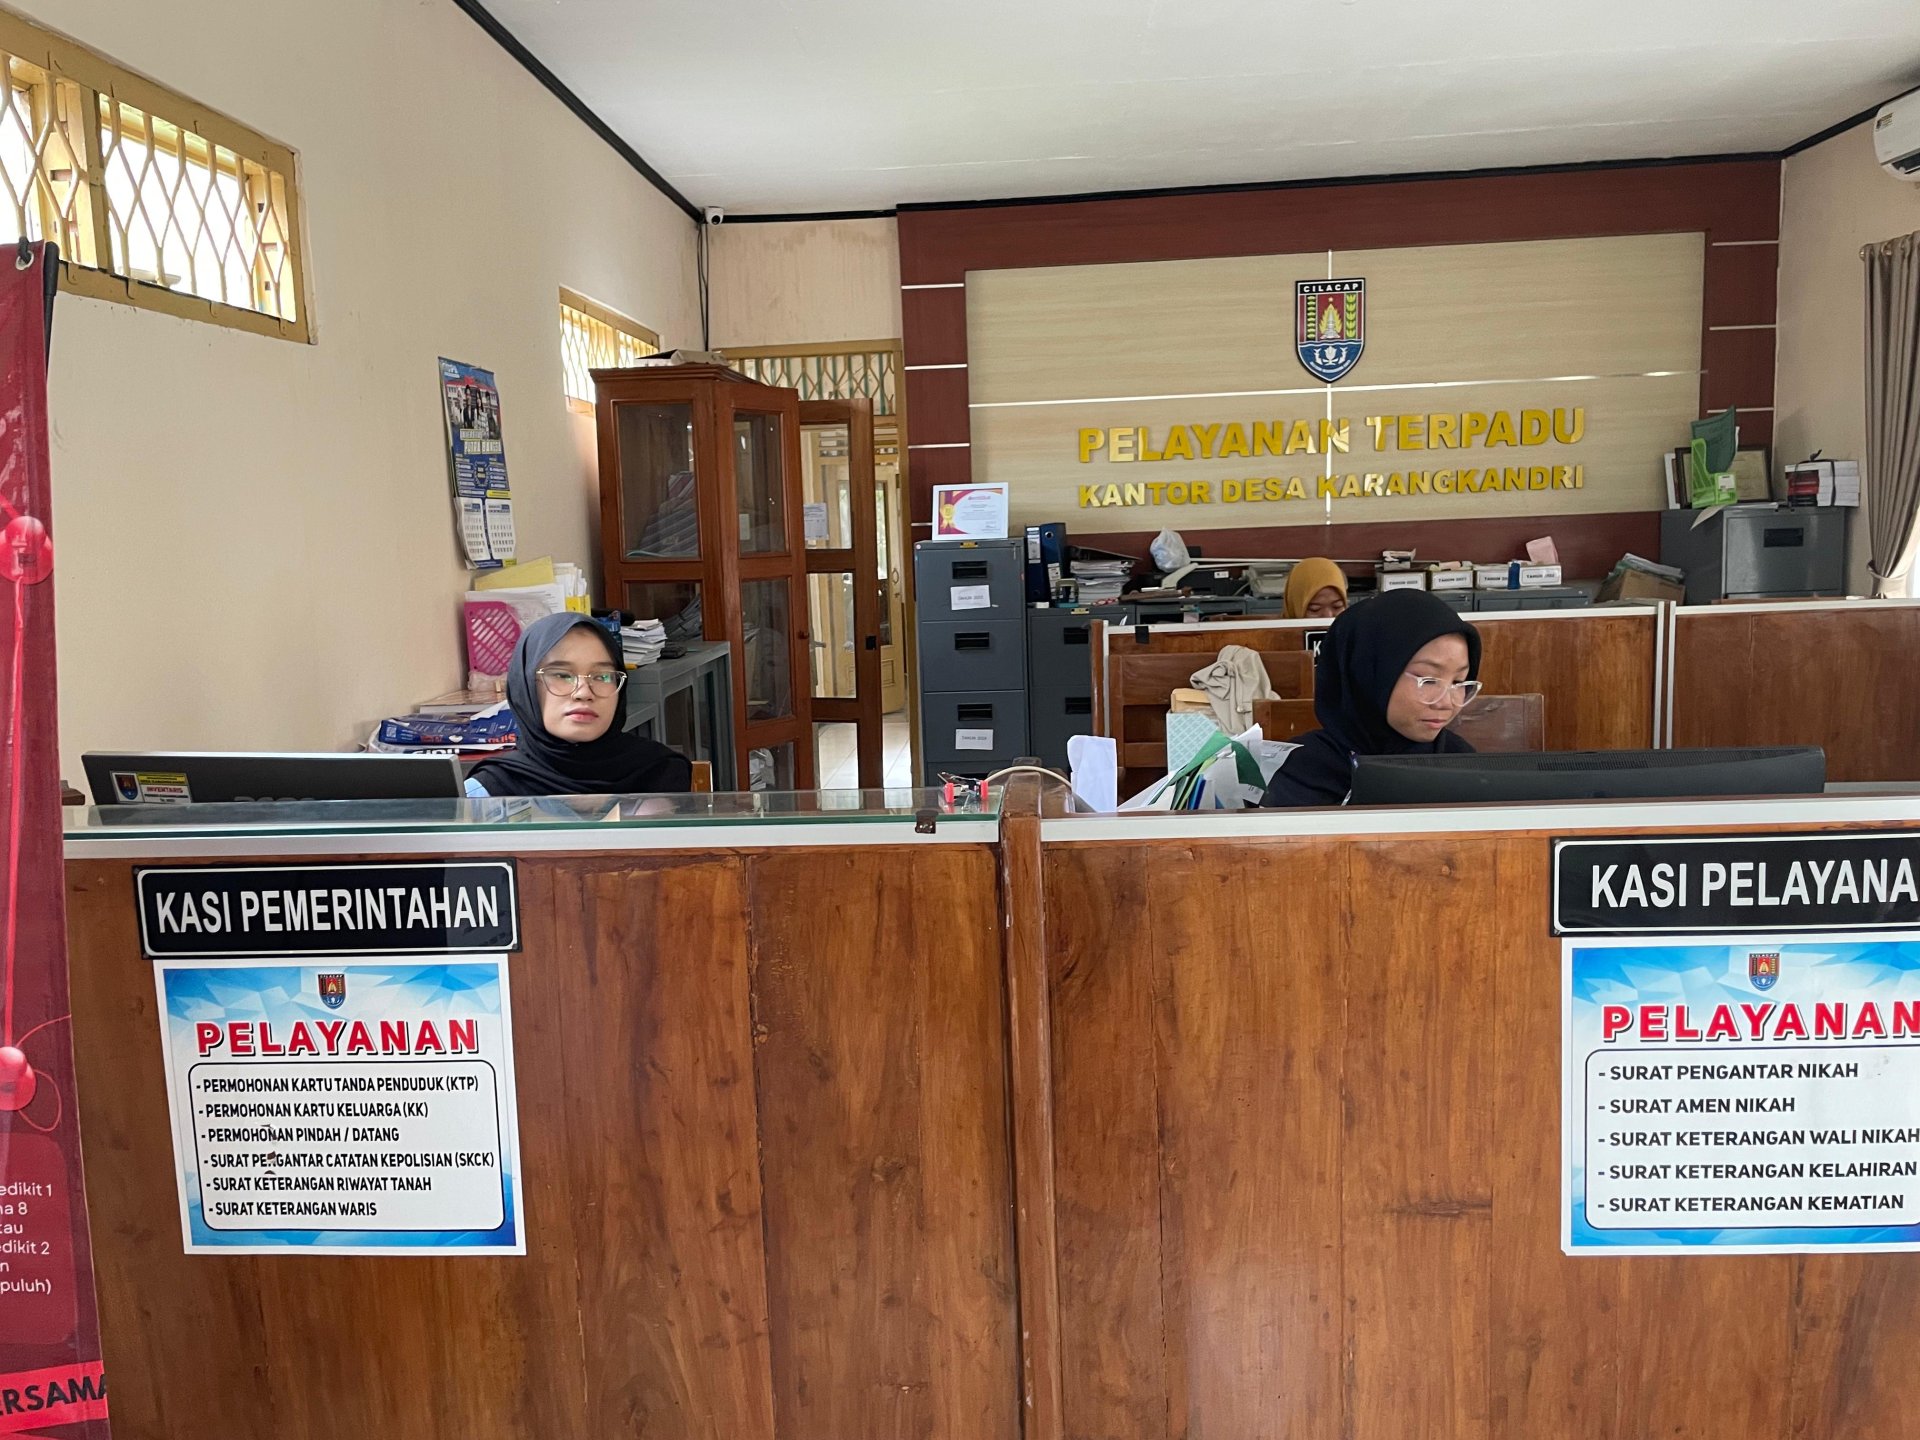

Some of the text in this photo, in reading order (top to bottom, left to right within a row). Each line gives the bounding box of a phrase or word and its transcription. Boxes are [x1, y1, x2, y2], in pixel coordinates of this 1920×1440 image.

[1303, 283, 1359, 293] CILACAP
[1078, 407, 1585, 462] PELAYANAN TERPADU
[1079, 464, 1585, 507] KANTOR DESA KARANGKANDRI
[1591, 858, 1919, 908] KASI PELAYANA
[156, 885, 499, 933] KASI PEMERINTAHAN
[1603, 1000, 1920, 1043] PELAYANAN
[196, 1019, 480, 1058] PELAYANAN
[1610, 1065, 1673, 1081] SURAT
[1677, 1064, 1793, 1080] PENGANTAR
[1798, 1062, 1858, 1078] NIKAH
[203, 1077, 289, 1093] PERMOHONAN
[291, 1077, 333, 1092] KARTU
[333, 1077, 376, 1092] TANDA
[376, 1076, 445, 1092] PENDUDUK
[446, 1075, 479, 1092] (KTP)
[205, 1103, 292, 1118] PERMOHONAN
[293, 1102, 335, 1117] KARTU
[336, 1102, 402, 1117] KELUARGA
[402, 1101, 429, 1118] (KK)
[1610, 1099, 1672, 1114] SURAT
[1675, 1098, 1731, 1113] AMEN
[1735, 1097, 1795, 1113] NIKAH
[208, 1125, 294, 1143] PERMOHONAN
[295, 1127, 341, 1142] PINDAH
[352, 1127, 400, 1142] DATANG
[1610, 1131, 1672, 1146] SURAT
[1676, 1130, 1805, 1146] KETERANGAN
[1809, 1129, 1857, 1145] WALI
[1862, 1128, 1920, 1144] NIKAH
[210, 1153, 250, 1168] SURAT
[325, 1153, 379, 1168] CATATAN
[380, 1152, 453, 1168] KEPOLISIAN
[454, 1151, 494, 1168] (SKCK)
[1609, 1164, 1671, 1180] SURAT
[1675, 1163, 1804, 1179] KETERANGAN
[1809, 1161, 1917, 1178] KELAHIRAN
[46, 1183, 52, 1197] 1
[212, 1176, 252, 1191] SURAT
[253, 1176, 335, 1191] KETERANGAN
[336, 1176, 389, 1191] RIWAYAT
[390, 1176, 432, 1191] TANAH
[18, 1201, 28, 1215] 8
[215, 1201, 254, 1216] SURAT
[256, 1201, 337, 1216] KETERANGAN
[337, 1202, 377, 1216] WARIS
[1609, 1197, 1671, 1212] SURAT
[1675, 1196, 1803, 1212] KETERANGAN
[1808, 1194, 1904, 1211] KEMATIAN
[0, 1239, 50, 1255] dikit 2
[0, 1278, 52, 1295] puluh)
